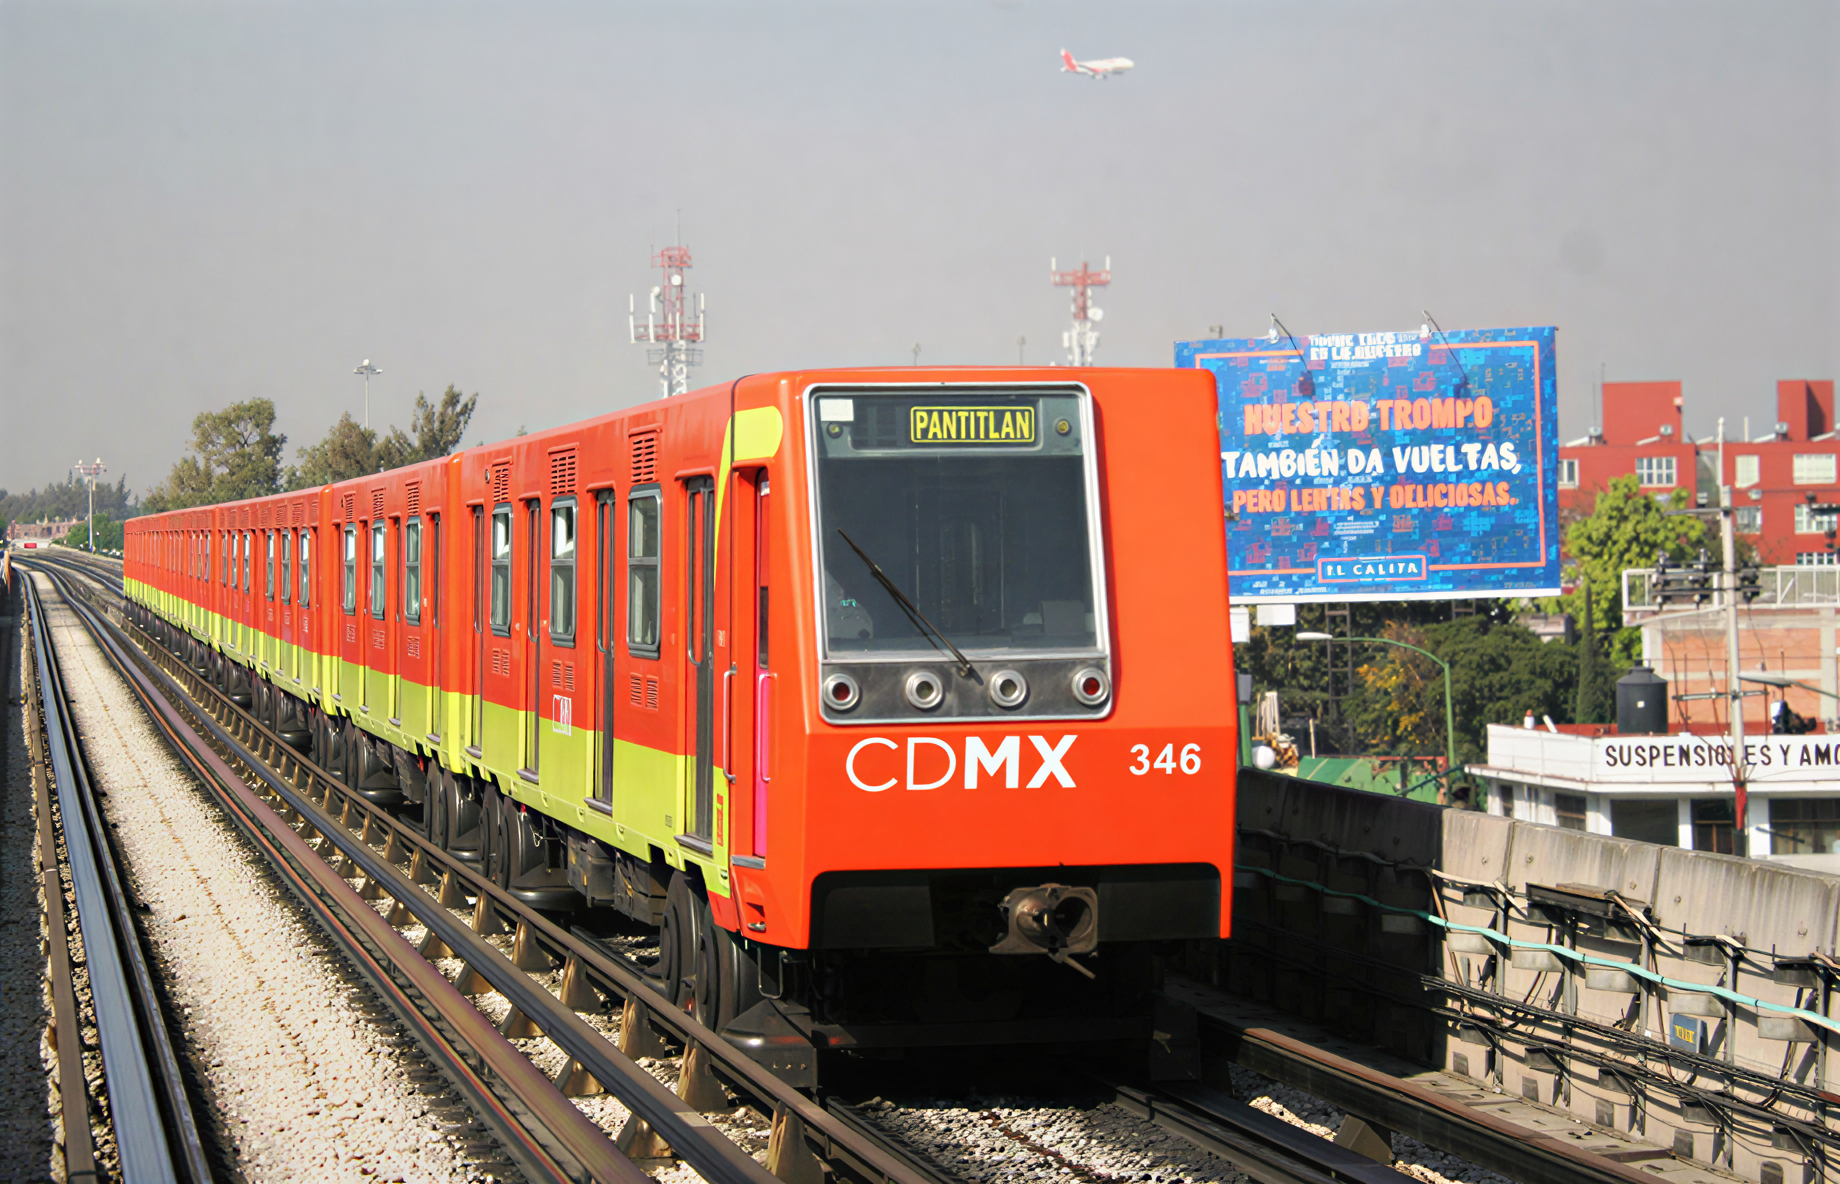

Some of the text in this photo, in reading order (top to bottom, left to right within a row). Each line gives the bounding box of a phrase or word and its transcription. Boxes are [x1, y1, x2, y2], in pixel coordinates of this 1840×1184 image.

[915, 411, 1030, 439] PANTITLAN
[1243, 395, 1493, 435] NUESTRO TROMPO
[1220, 433, 1522, 479] TAMBIÉN DA VUELTAS,
[1232, 488, 1287, 513] PERO
[1290, 486, 1366, 512] LENTAS
[1370, 485, 1385, 509] Y
[846, 734, 1078, 792] CDMX
[1129, 743, 1201, 775] 346
[1779, 743, 1791, 766] Y
